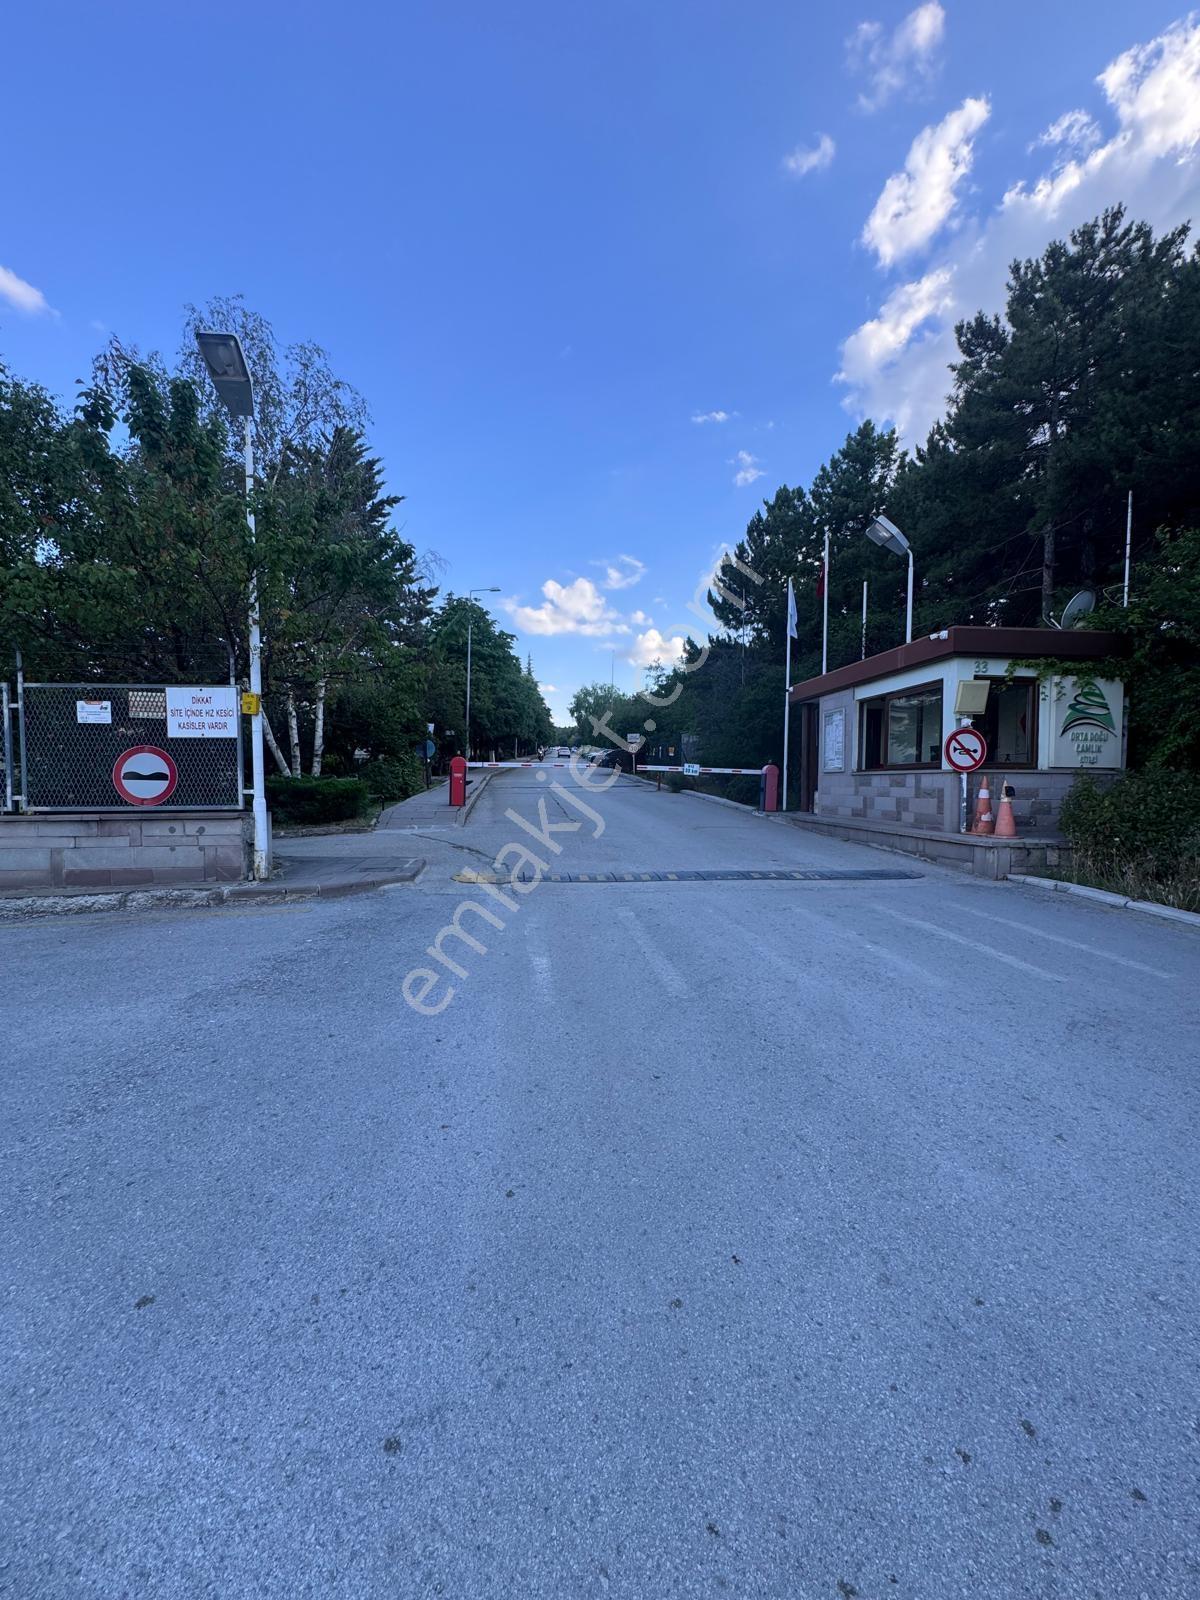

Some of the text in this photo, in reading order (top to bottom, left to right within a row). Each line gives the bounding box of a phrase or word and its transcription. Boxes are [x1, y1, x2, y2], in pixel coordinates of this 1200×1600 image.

[974, 660, 989, 674] 33
[191, 695, 212, 705] DİKKAT
[170, 707, 183, 718] SİTE
[184, 707, 204, 719] İÇİNDE
[205, 708, 215, 718] HIZ
[207, 721, 228, 730] VARDIR
[1071, 730, 1109, 743] ORTA DOĞU
